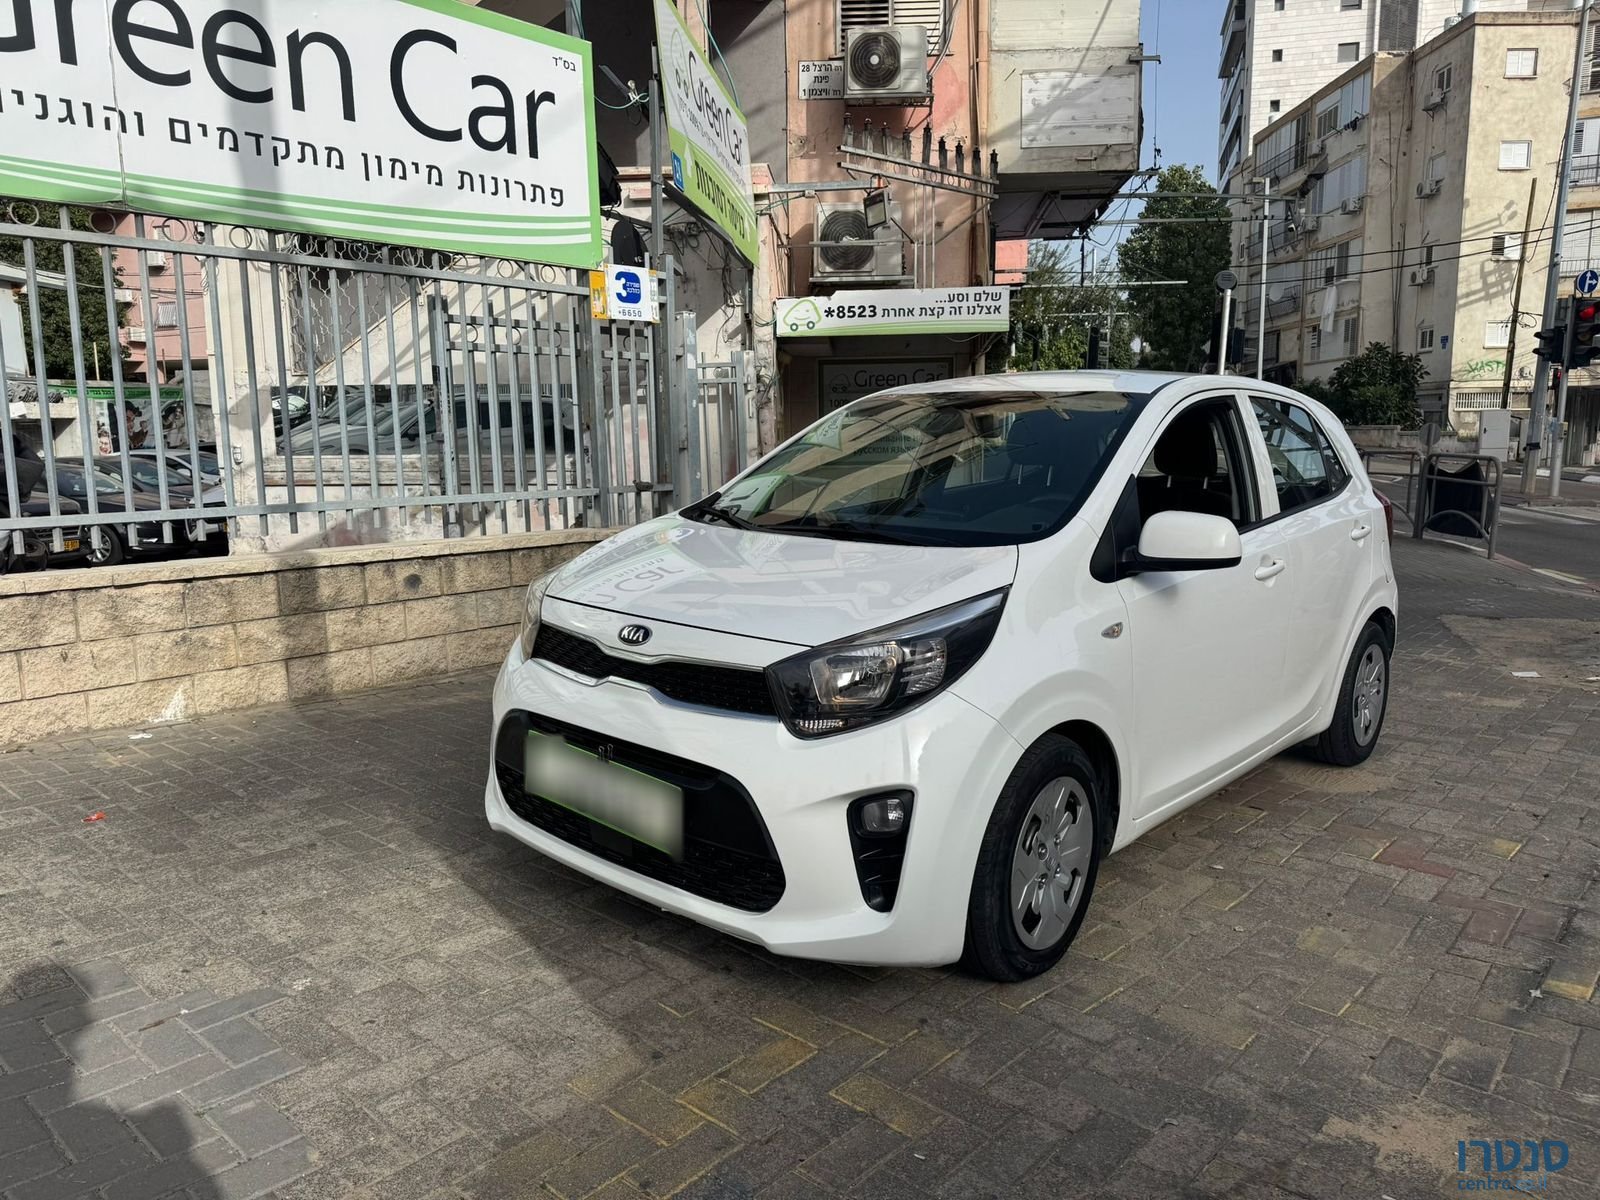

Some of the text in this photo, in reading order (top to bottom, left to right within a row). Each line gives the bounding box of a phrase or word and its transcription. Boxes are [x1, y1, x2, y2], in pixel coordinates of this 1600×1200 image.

[801, 64, 810, 72] 28
[812, 62, 833, 72] הרצל
[813, 75, 830, 84] פינת
[389, 28, 555, 160] Car
[802, 88, 806, 96] 1
[688, 50, 727, 147] Green
[725, 107, 743, 166] Car
[0, 88, 564, 207] פתרונות מימון מתקדמים והוגני
[935, 290, 1002, 304] שלם וסע...
[881, 307, 915, 318] אחרת
[919, 306, 945, 319] קצת
[949, 305, 963, 316] זה
[966, 303, 1001, 315] אצלנו
[854, 369, 907, 388] Green
[620, 626, 645, 641] KIA
